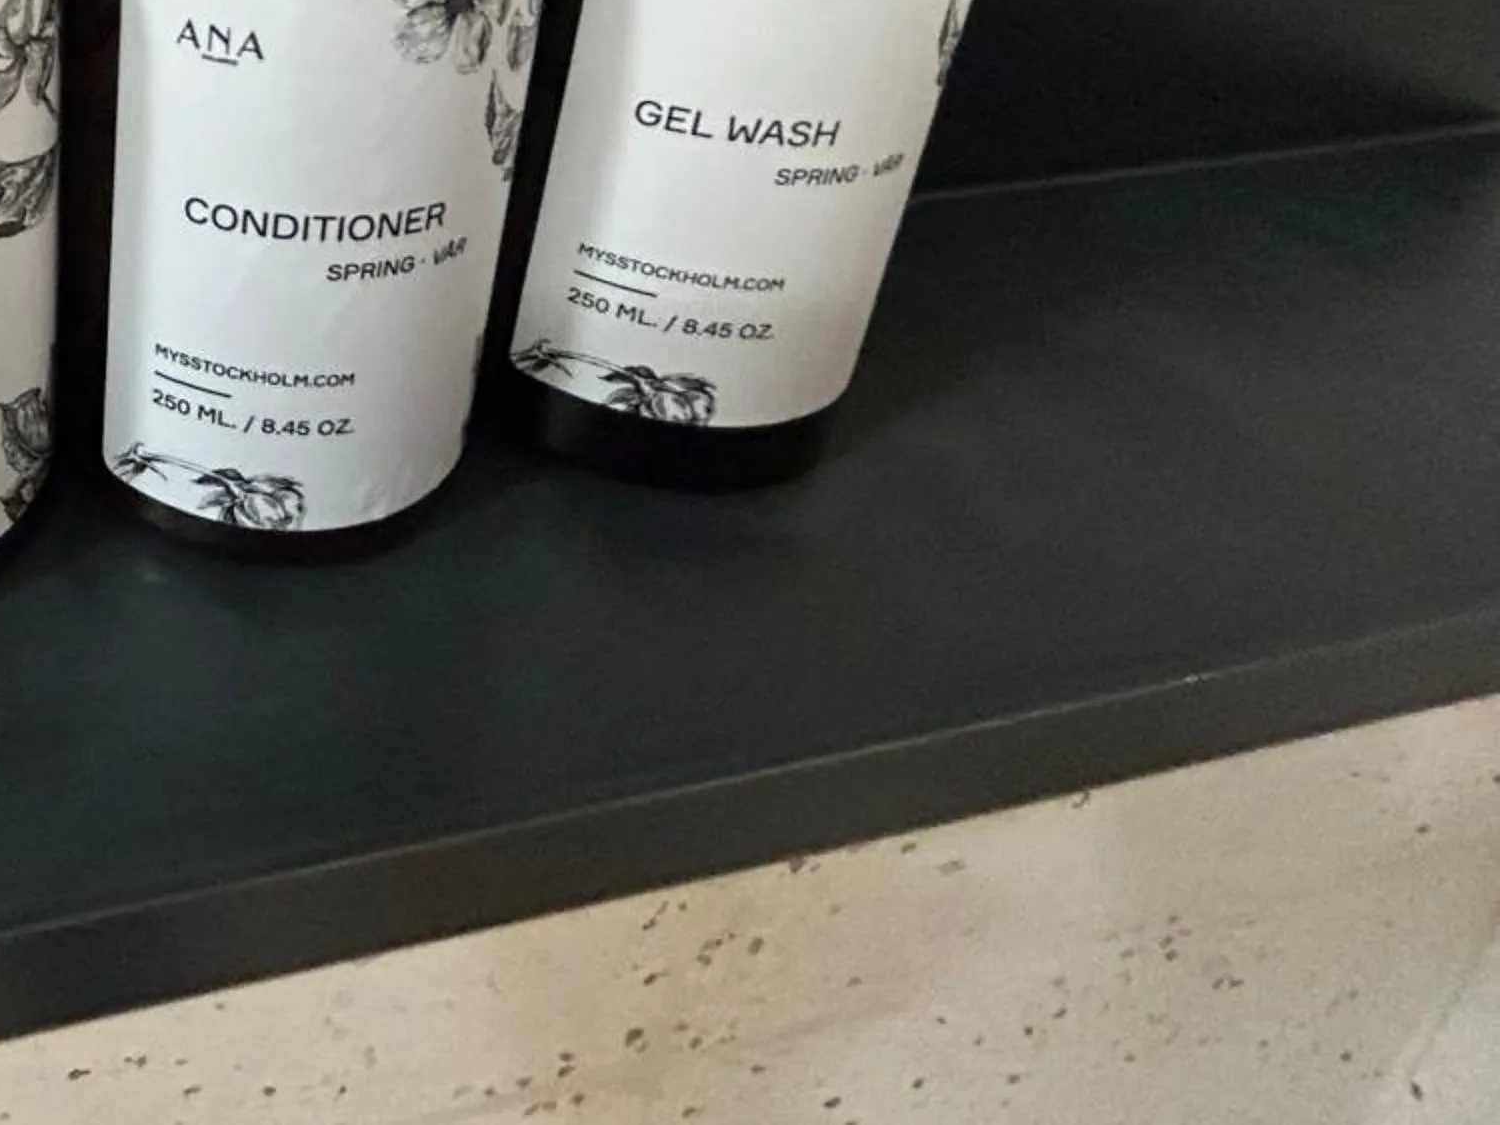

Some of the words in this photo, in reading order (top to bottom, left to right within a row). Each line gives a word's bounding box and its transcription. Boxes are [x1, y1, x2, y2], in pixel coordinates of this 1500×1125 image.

[175, 18, 266, 62] ANA
[633, 100, 714, 140] GEL
[727, 114, 842, 149] WASH
[773, 164, 861, 188] SPRING
[184, 197, 447, 245] CONDITIONER
[325, 254, 416, 283] SPRING
[576, 242, 786, 292] MYSSTOCKHOLM.COM
[567, 287, 611, 315] 250
[663, 314, 680, 334] /
[681, 318, 734, 340] 8.45
[154, 342, 357, 388] MYSSTOCKHOLM.COM
[152, 388, 194, 417] 250
[196, 403, 238, 430] ML.
[242, 415, 257, 435] /
[260, 418, 312, 437] 8.45
